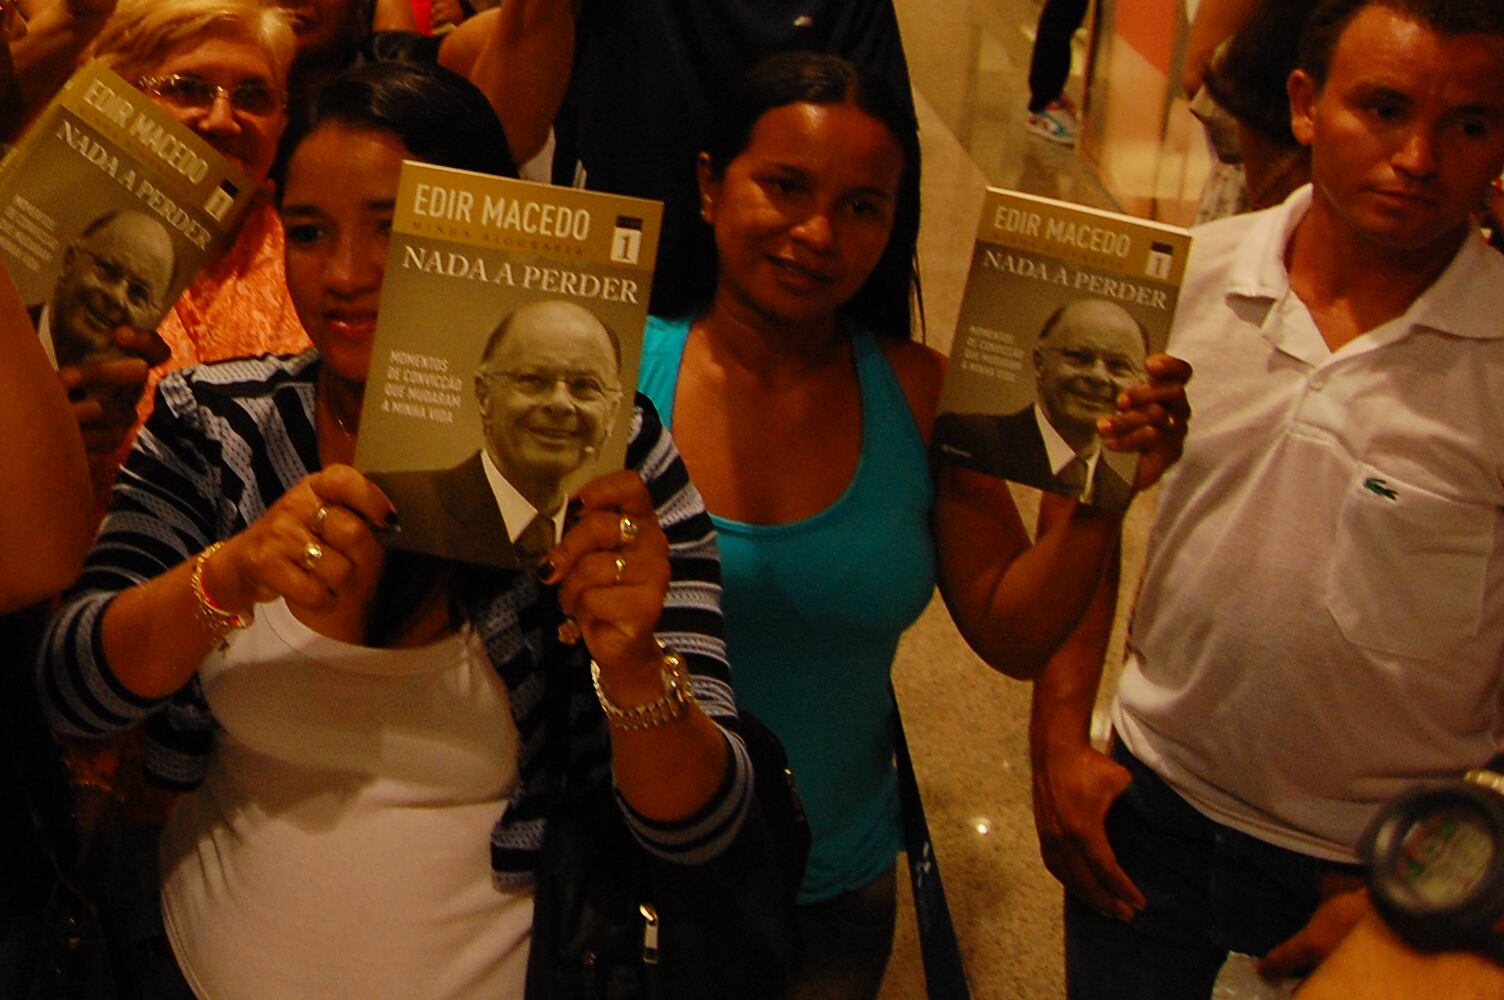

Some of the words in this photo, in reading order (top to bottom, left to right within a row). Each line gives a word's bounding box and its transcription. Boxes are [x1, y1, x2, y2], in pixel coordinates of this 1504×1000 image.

[83, 79, 134, 128] EDIR
[130, 113, 209, 184] MACEDO
[55, 119, 120, 178] NADA
[118, 168, 137, 191] A
[136, 178, 213, 251] PERDER
[413, 183, 474, 223] EDIR
[481, 194, 592, 242] MACEDO
[993, 205, 1042, 238] EDIR
[1046, 217, 1131, 259] MACEDO
[402, 245, 489, 283] NADA
[494, 262, 515, 287] A
[520, 263, 639, 305] PERDER
[983, 249, 1049, 282] NADA
[1051, 267, 1069, 287] A
[1073, 271, 1168, 310] PERDER
